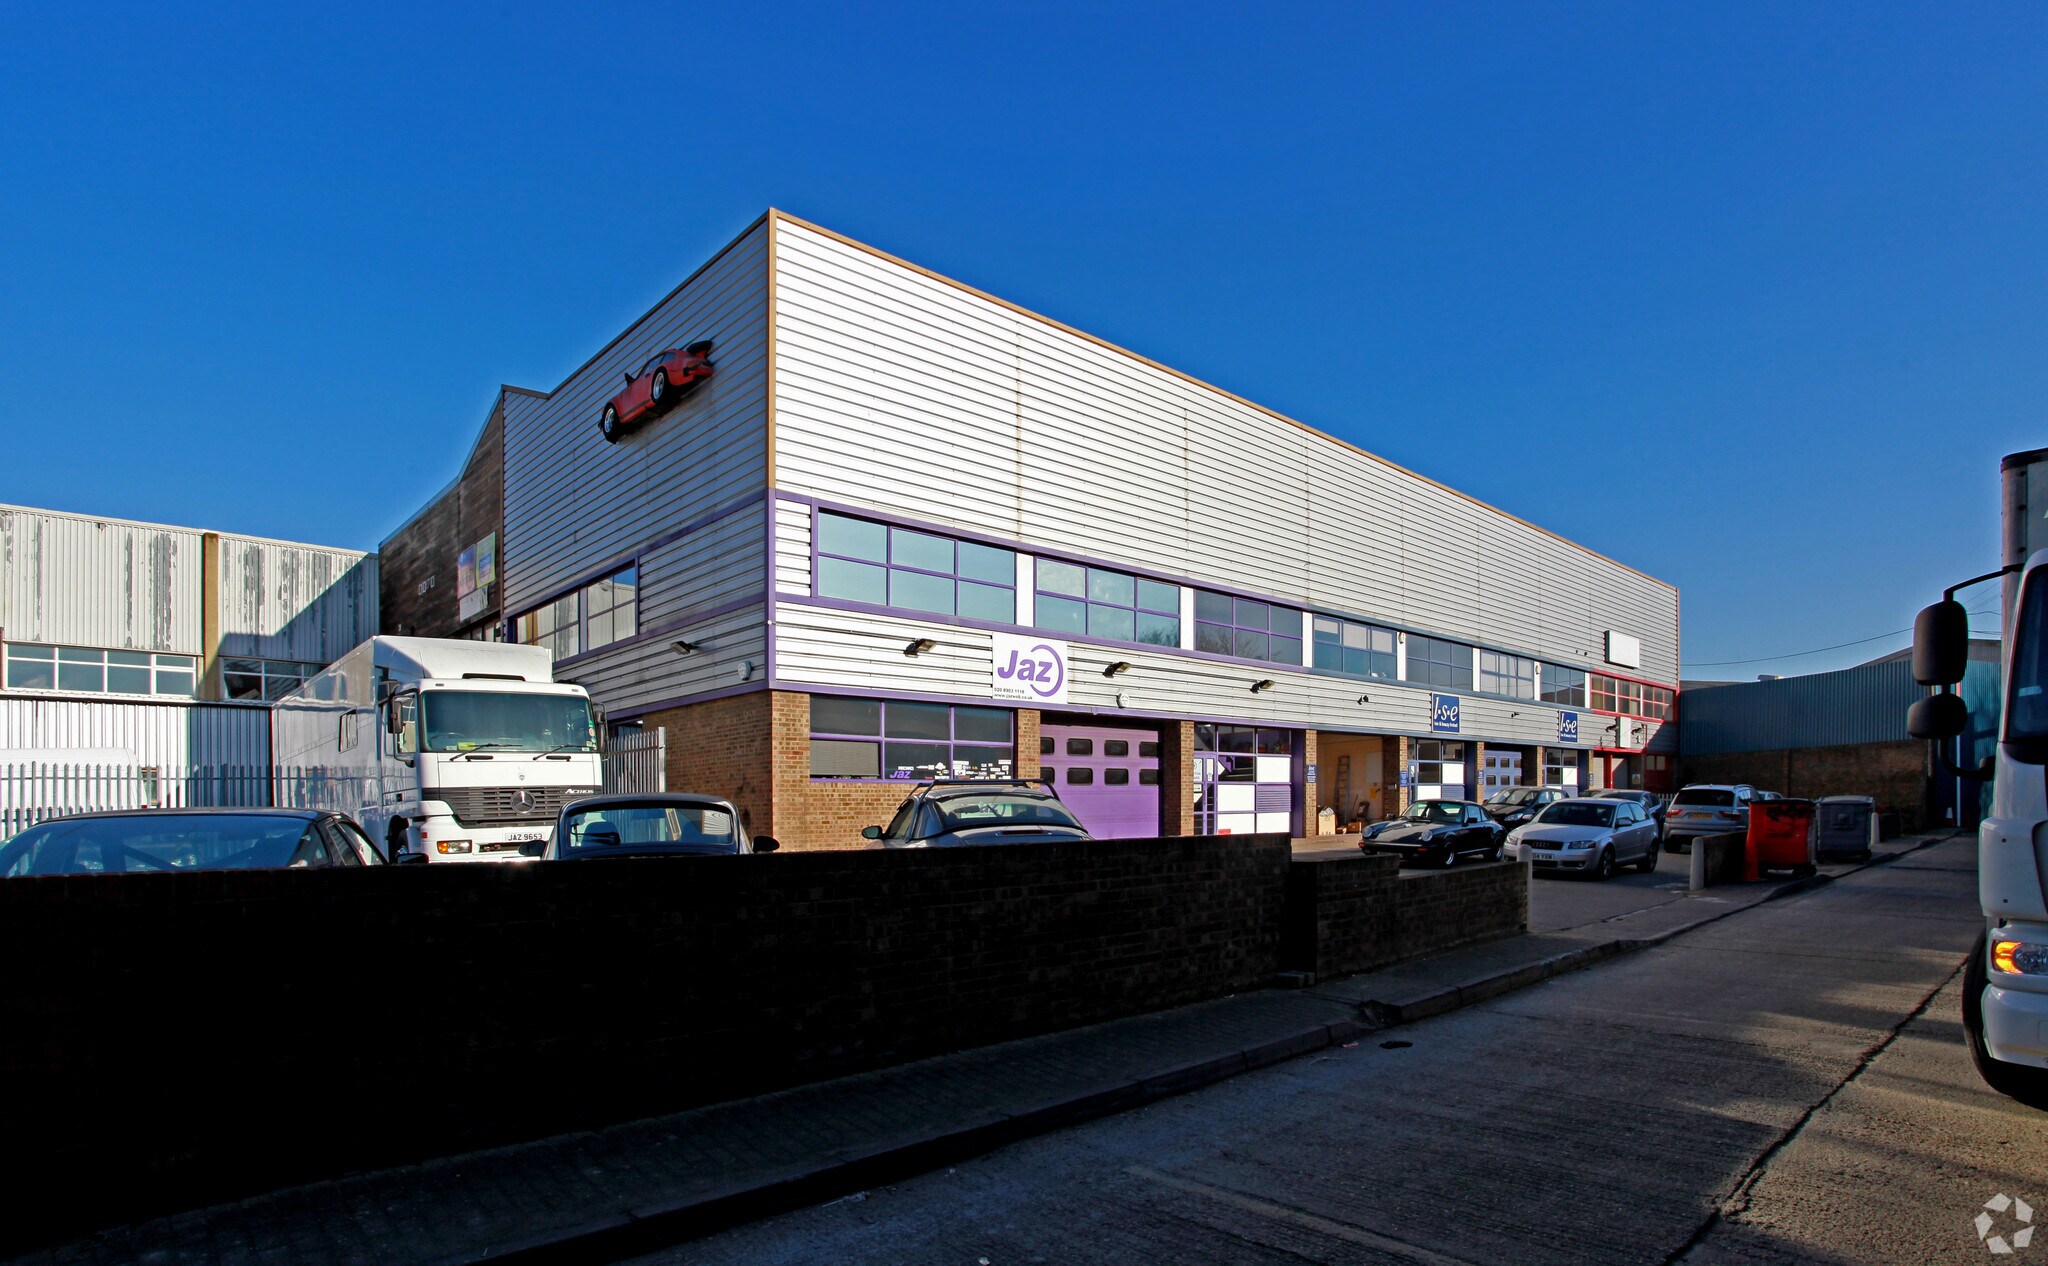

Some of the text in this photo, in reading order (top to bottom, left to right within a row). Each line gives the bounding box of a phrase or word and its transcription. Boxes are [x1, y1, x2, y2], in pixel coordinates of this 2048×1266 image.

[997, 650, 1053, 683] Jaz
[508, 833, 543, 841] JAZ 9653
